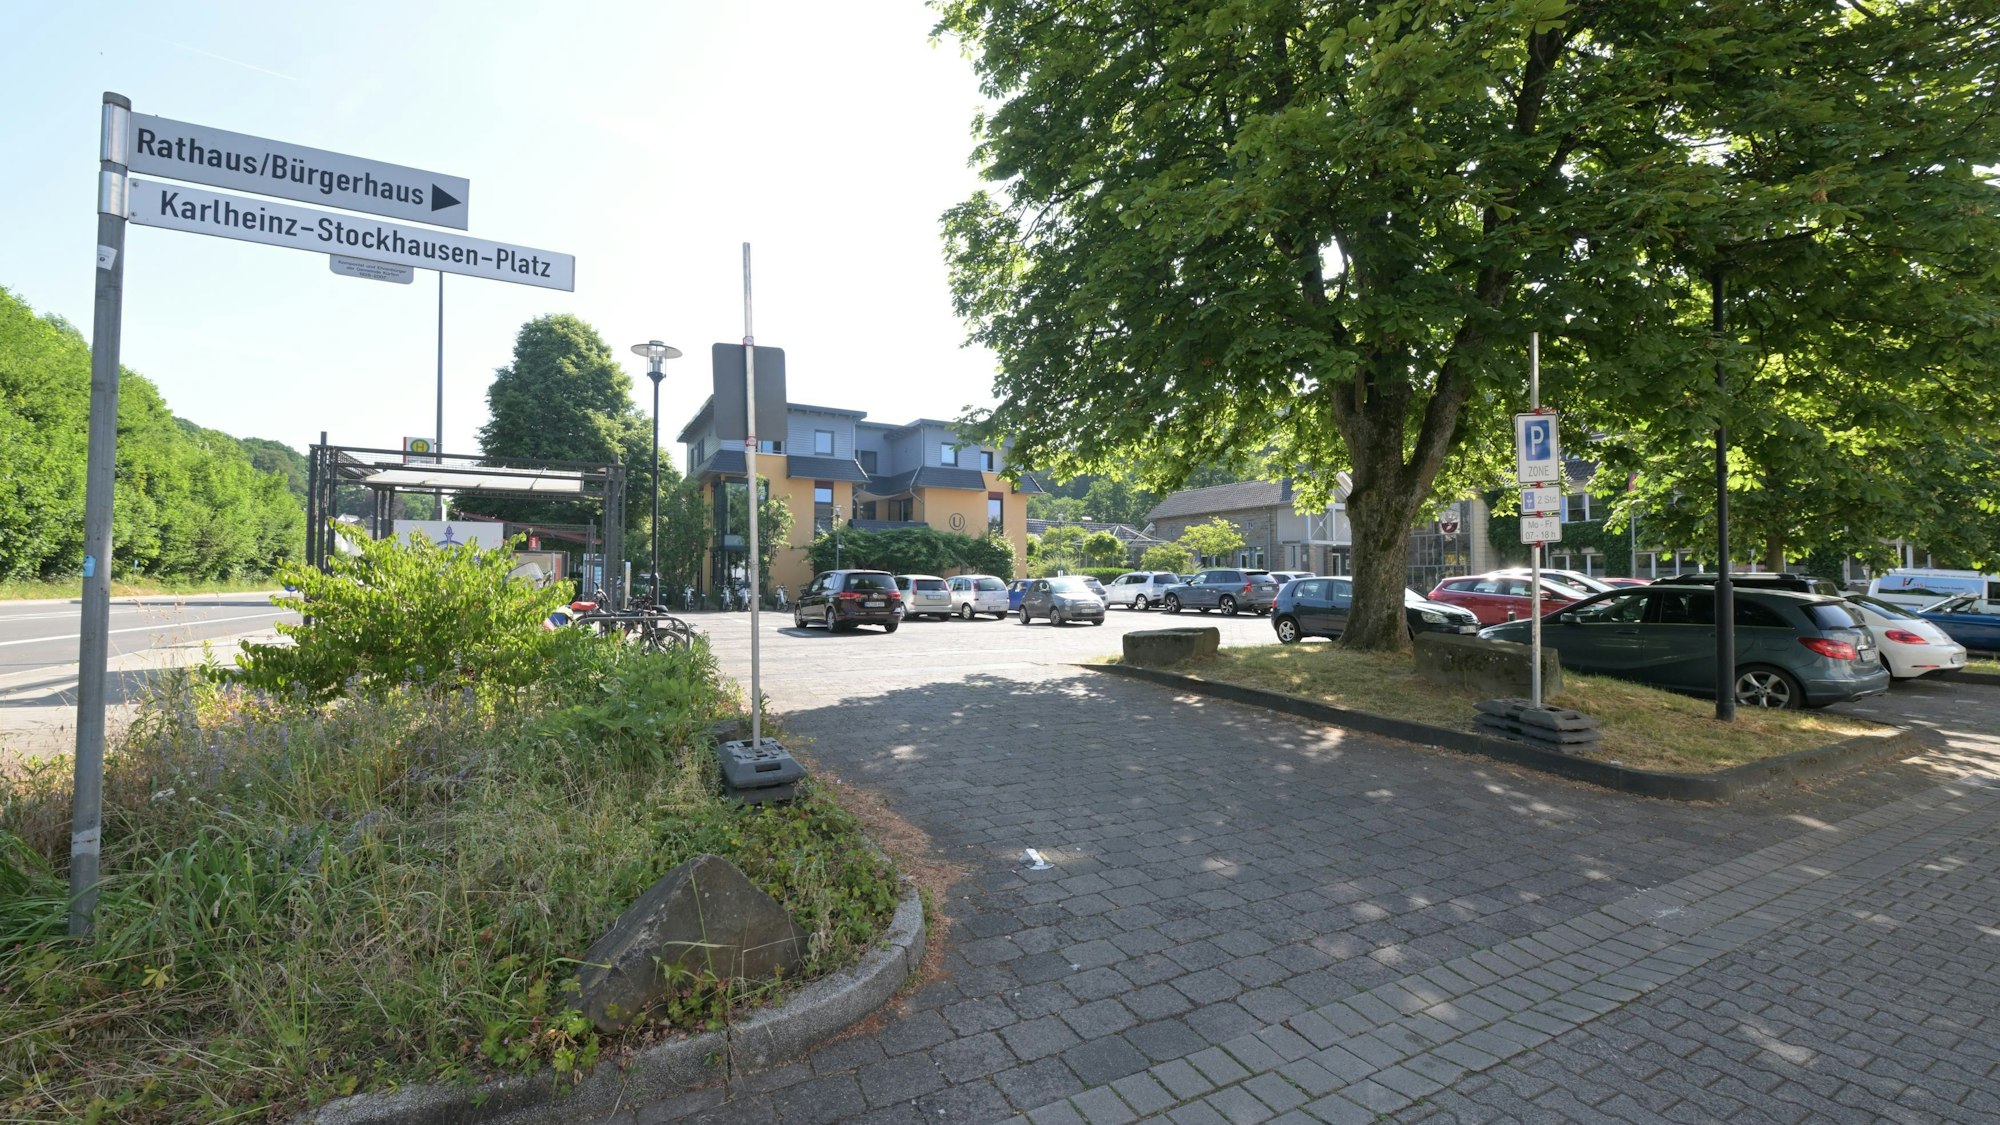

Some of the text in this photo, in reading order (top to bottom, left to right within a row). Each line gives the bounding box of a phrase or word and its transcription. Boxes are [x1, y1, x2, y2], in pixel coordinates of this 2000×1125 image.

[137, 128, 424, 205] Rathaus/Bürgerhaus
[160, 190, 551, 278] Karlheinz-Stockhausen-Platz
[1530, 425, 1544, 455] P
[1528, 465, 1550, 477] ZONE
[1537, 495, 1544, 505] 2
[1528, 520, 1539, 529] Mo
[1545, 519, 1553, 528] Fr
[1525, 531, 1534, 540] 07
[1541, 530, 1550, 539] 18
[1550, 530, 1556, 539] h
